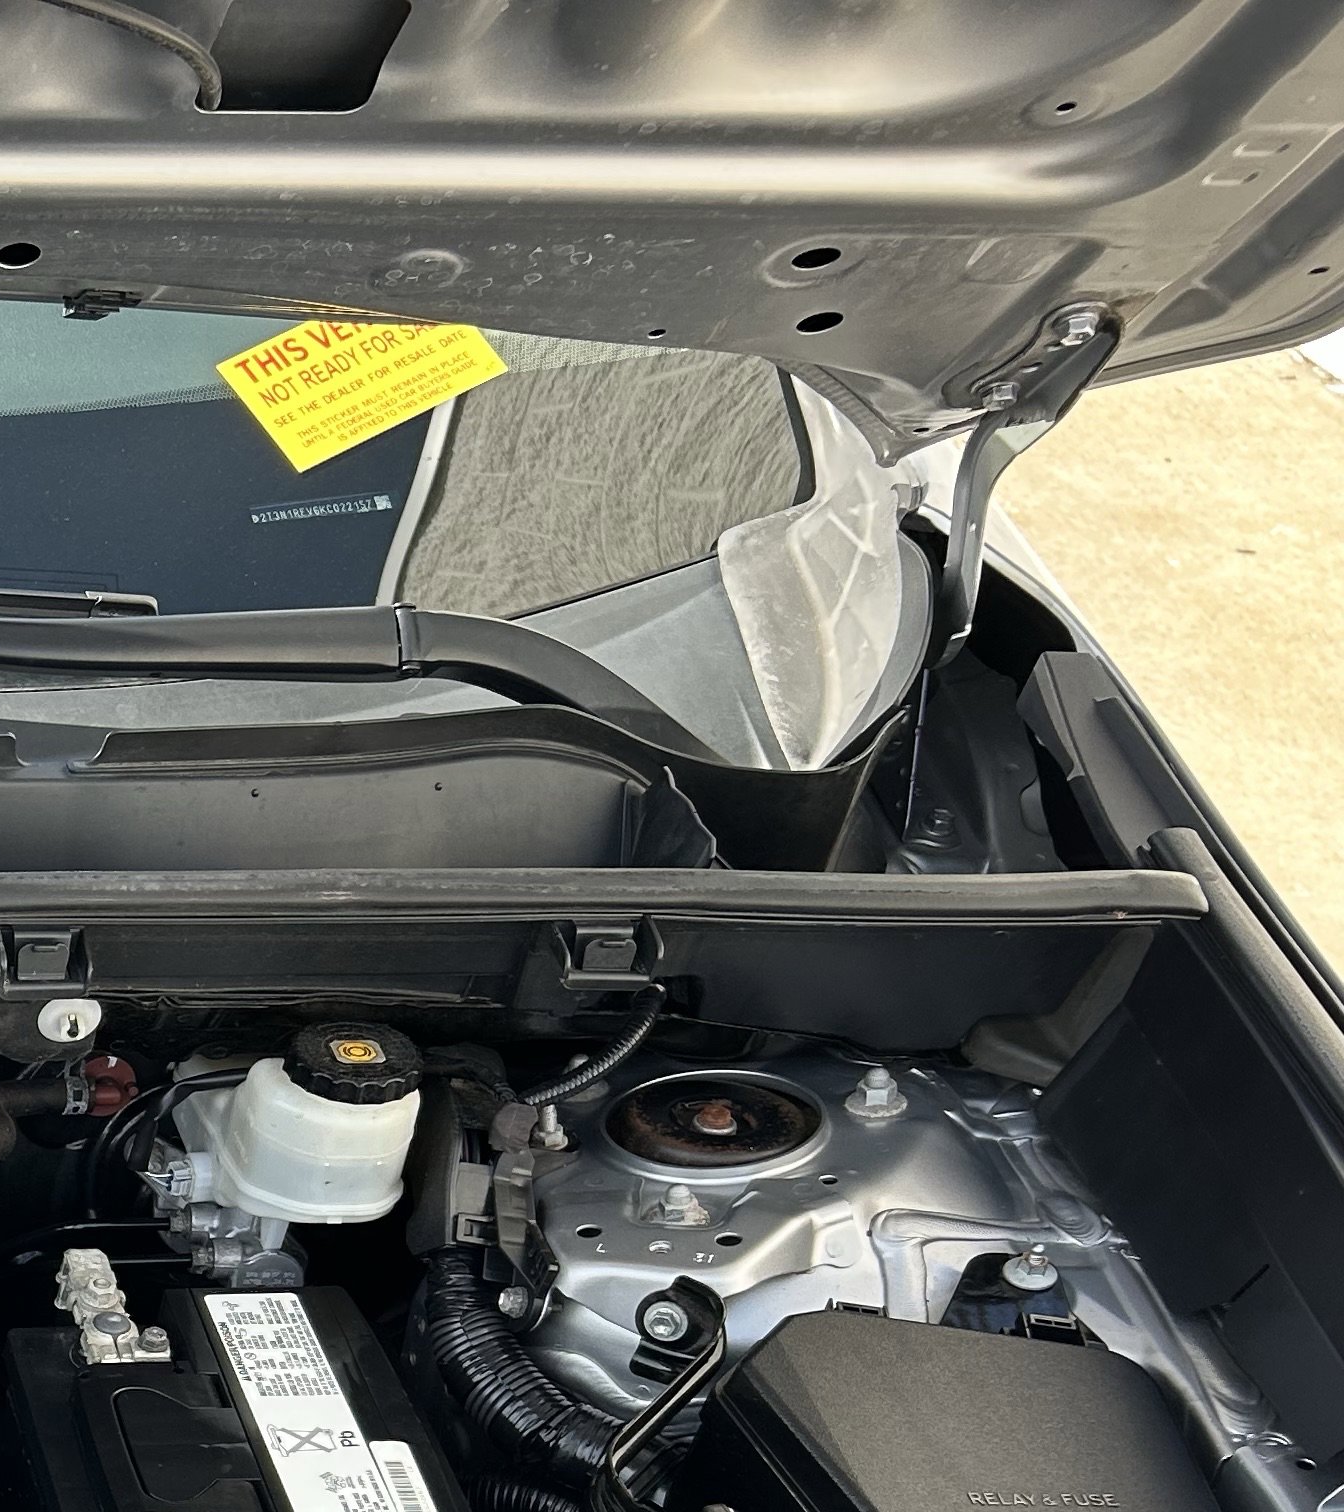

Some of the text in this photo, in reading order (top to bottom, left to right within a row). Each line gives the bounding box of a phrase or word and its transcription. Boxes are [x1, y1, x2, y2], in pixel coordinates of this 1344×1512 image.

[234, 338, 309, 383] THIS
[258, 377, 300, 408] NOT
[298, 346, 361, 390] READY
[358, 329, 403, 360] FOR
[399, 324, 438, 341] SA
[274, 329, 467, 428] SEE THE DEALER FOR RESALE DATE
[296, 425, 319, 439] THIS
[320, 405, 359, 428] STICKER
[362, 390, 389, 407] MUST
[392, 371, 427, 392] REMAIN
[429, 365, 439, 375] IN
[440, 350, 470, 370] PLACE
[302, 433, 327, 448] UNTIL
[335, 410, 373, 431] FEDERAL
[375, 397, 398, 414] USED
[399, 388, 417, 401] CAR
[451, 358, 478, 375] GUIDE
[337, 382, 453, 442] IS AFFIXED TO THIS VEHICLE
[337, 1430, 361, 1448] Pb
[967, 1491, 1120, 1507] RELAY & FUSE
